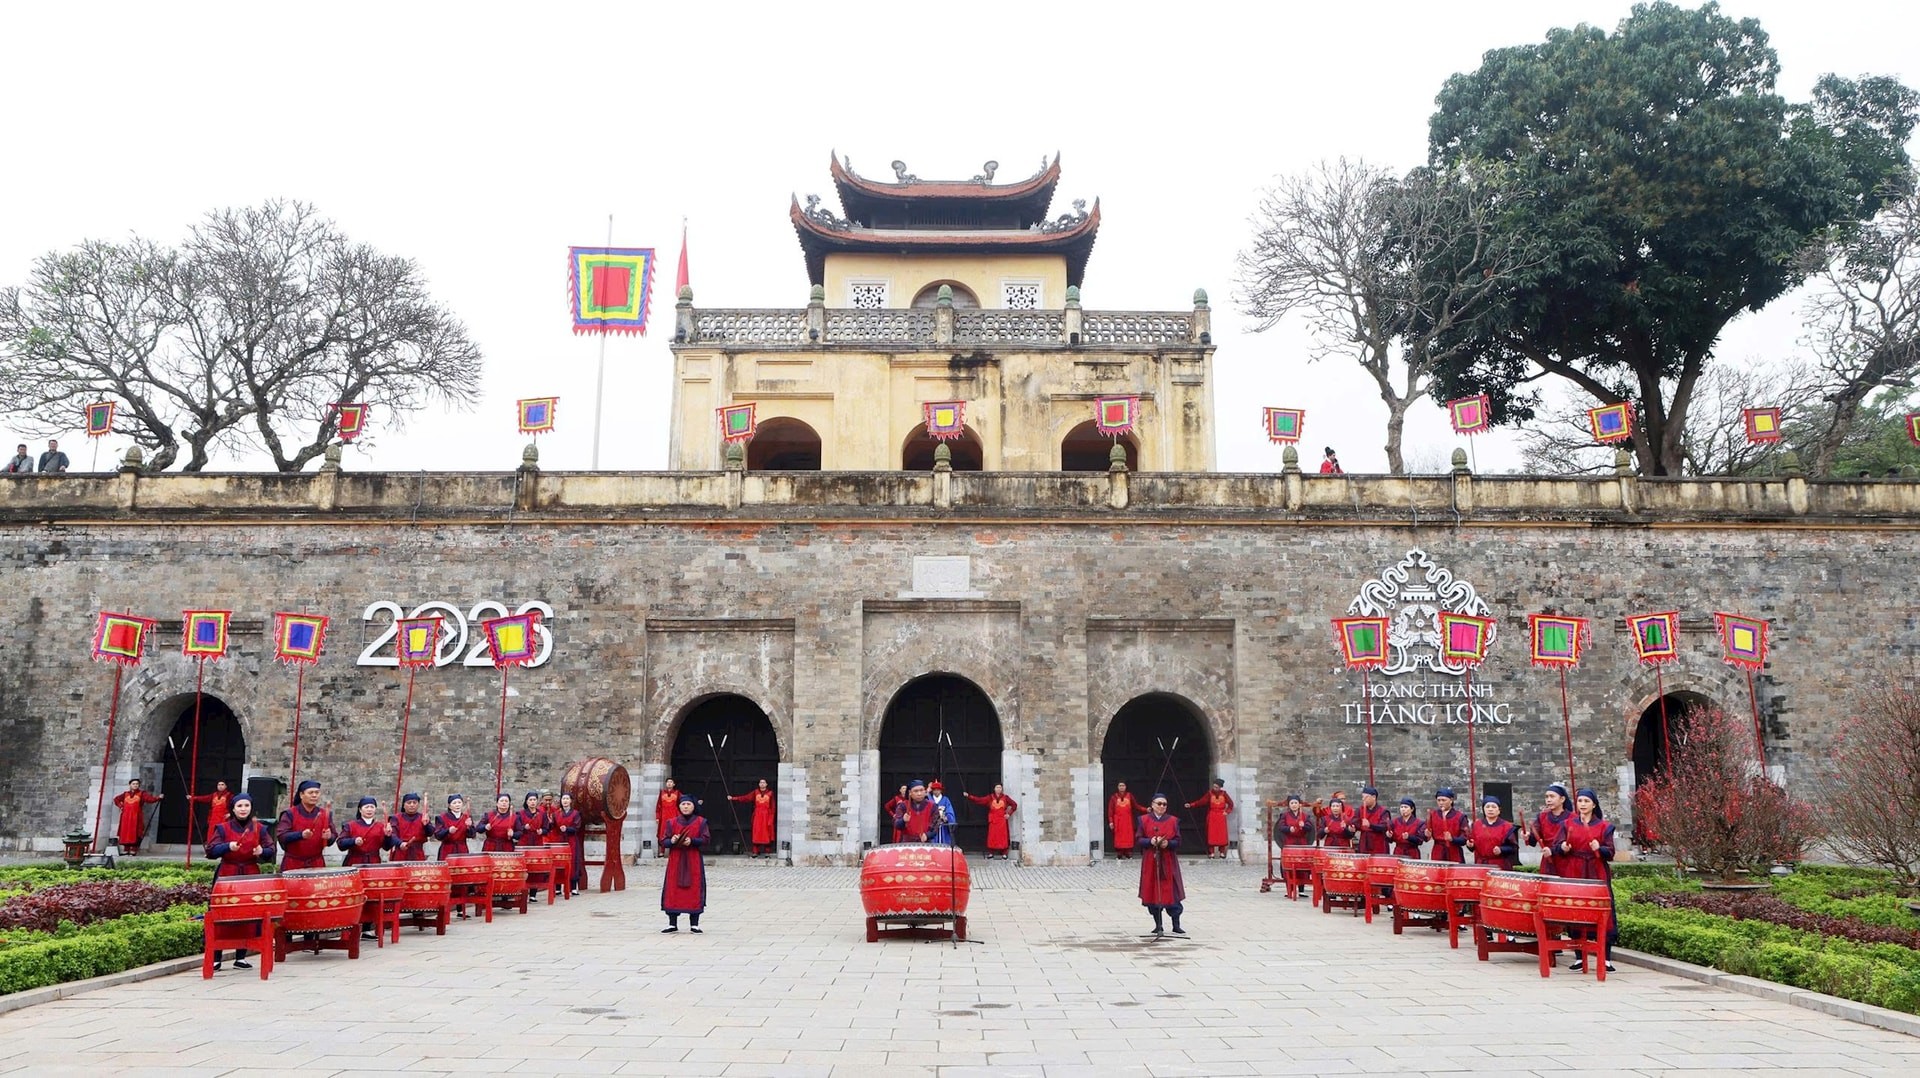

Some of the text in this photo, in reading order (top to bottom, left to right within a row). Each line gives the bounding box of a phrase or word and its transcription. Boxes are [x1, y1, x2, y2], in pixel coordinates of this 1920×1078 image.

[1362, 681, 1494, 698] HOÀNG THÀNH
[1340, 699, 1513, 725] THĂNG LONG
